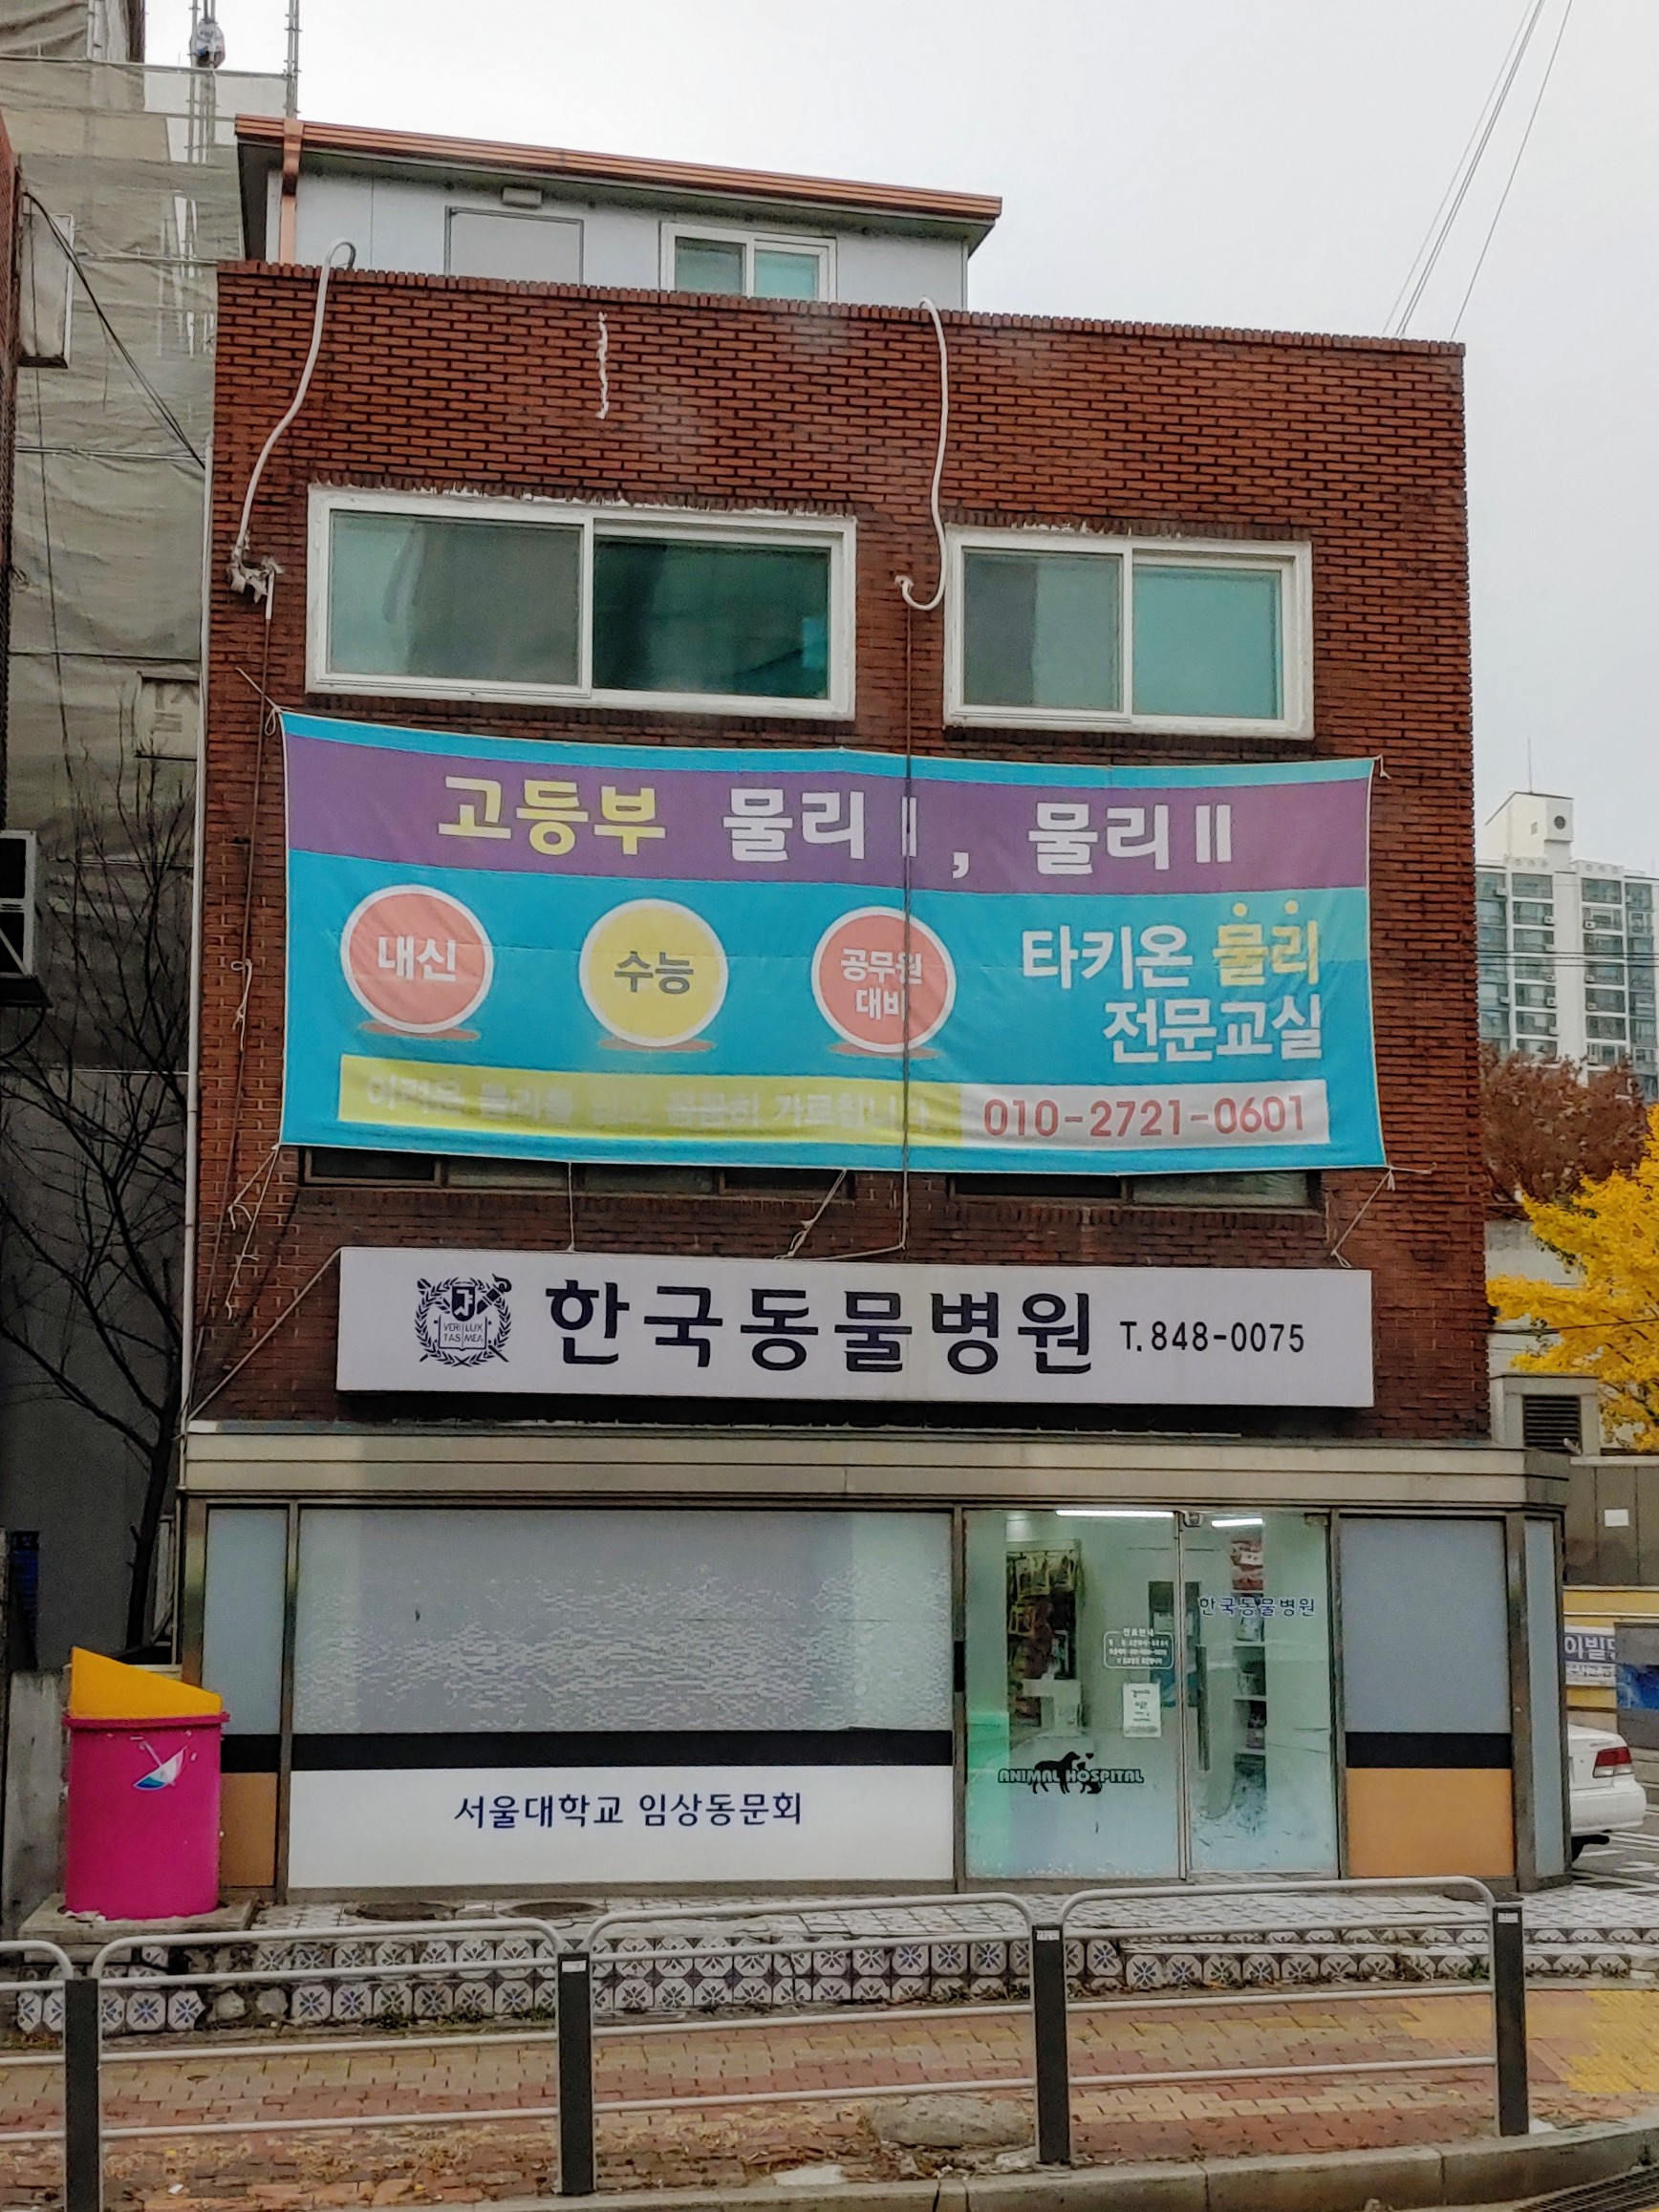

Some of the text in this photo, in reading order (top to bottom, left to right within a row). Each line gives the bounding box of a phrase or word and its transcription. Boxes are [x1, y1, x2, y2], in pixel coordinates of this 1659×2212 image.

[438, 775, 665, 856] 고등부
[377, 934, 456, 982] 내신
[614, 951, 694, 995] 수능
[841, 948, 922, 985] 공무원
[1022, 919, 1319, 989] 타키온 물리
[855, 987, 909, 1021] 대비
[1103, 993, 1323, 1063] 전문교실
[983, 1094, 1304, 1137] 010-2721-0601
[545, 1279, 1305, 1375] 한국동물병원 T.848-0075
[1199, 1597, 1314, 1617] 한국동물병원
[998, 1769, 1144, 1783] ANIMAL HOSPITAL
[455, 1792, 803, 1829] 서울대학교 임상동문회
